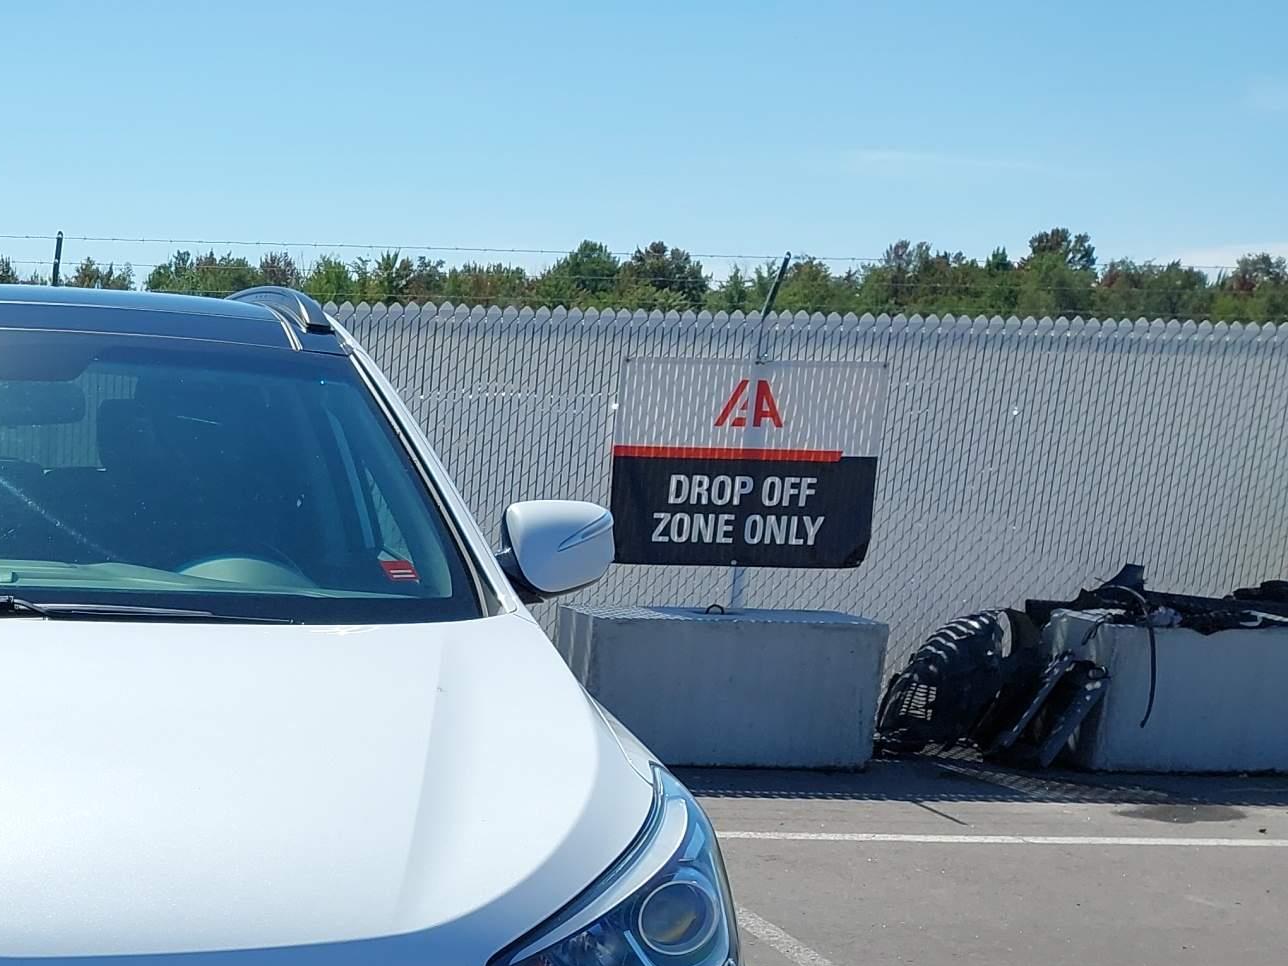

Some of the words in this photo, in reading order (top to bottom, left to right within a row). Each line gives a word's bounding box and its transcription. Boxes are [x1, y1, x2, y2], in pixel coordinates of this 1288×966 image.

[668, 474, 754, 506] DROP
[761, 476, 818, 507] OFF
[651, 512, 736, 544] ZONE
[743, 514, 825, 546] ONLY
